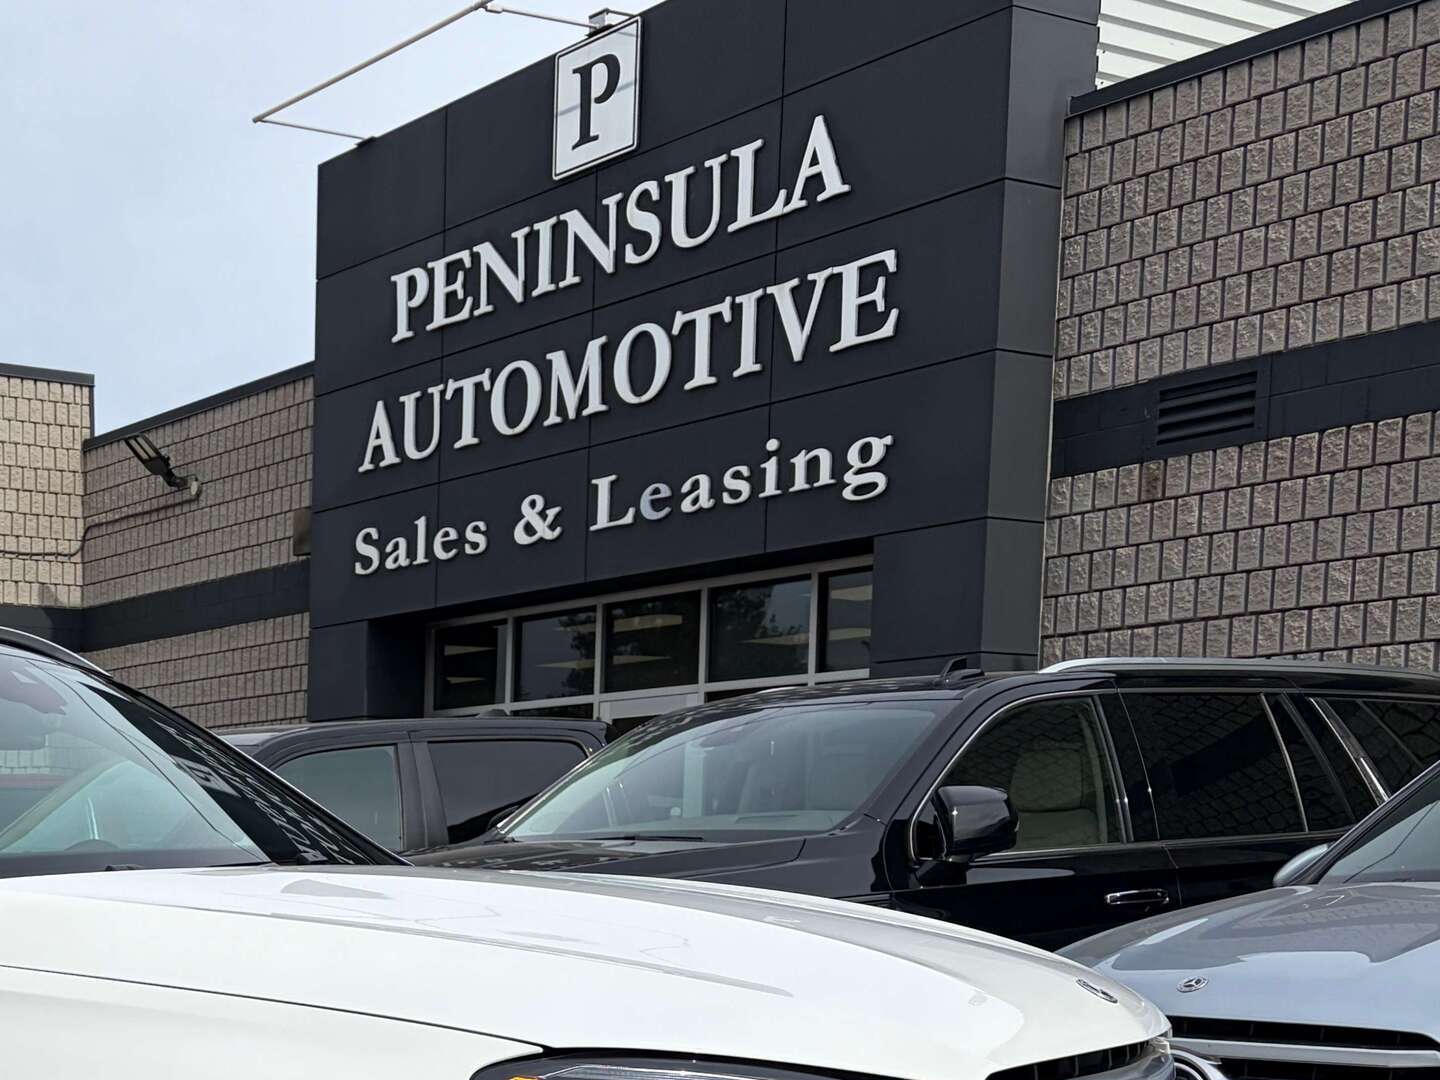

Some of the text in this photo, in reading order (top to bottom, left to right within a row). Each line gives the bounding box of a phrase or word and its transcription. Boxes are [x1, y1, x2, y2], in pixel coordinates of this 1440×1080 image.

[571, 53, 621, 151] P
[390, 115, 852, 343] PENINSULA
[358, 249, 899, 472] AUTOMOTIVE
[354, 434, 894, 574] Sales & Leasing
